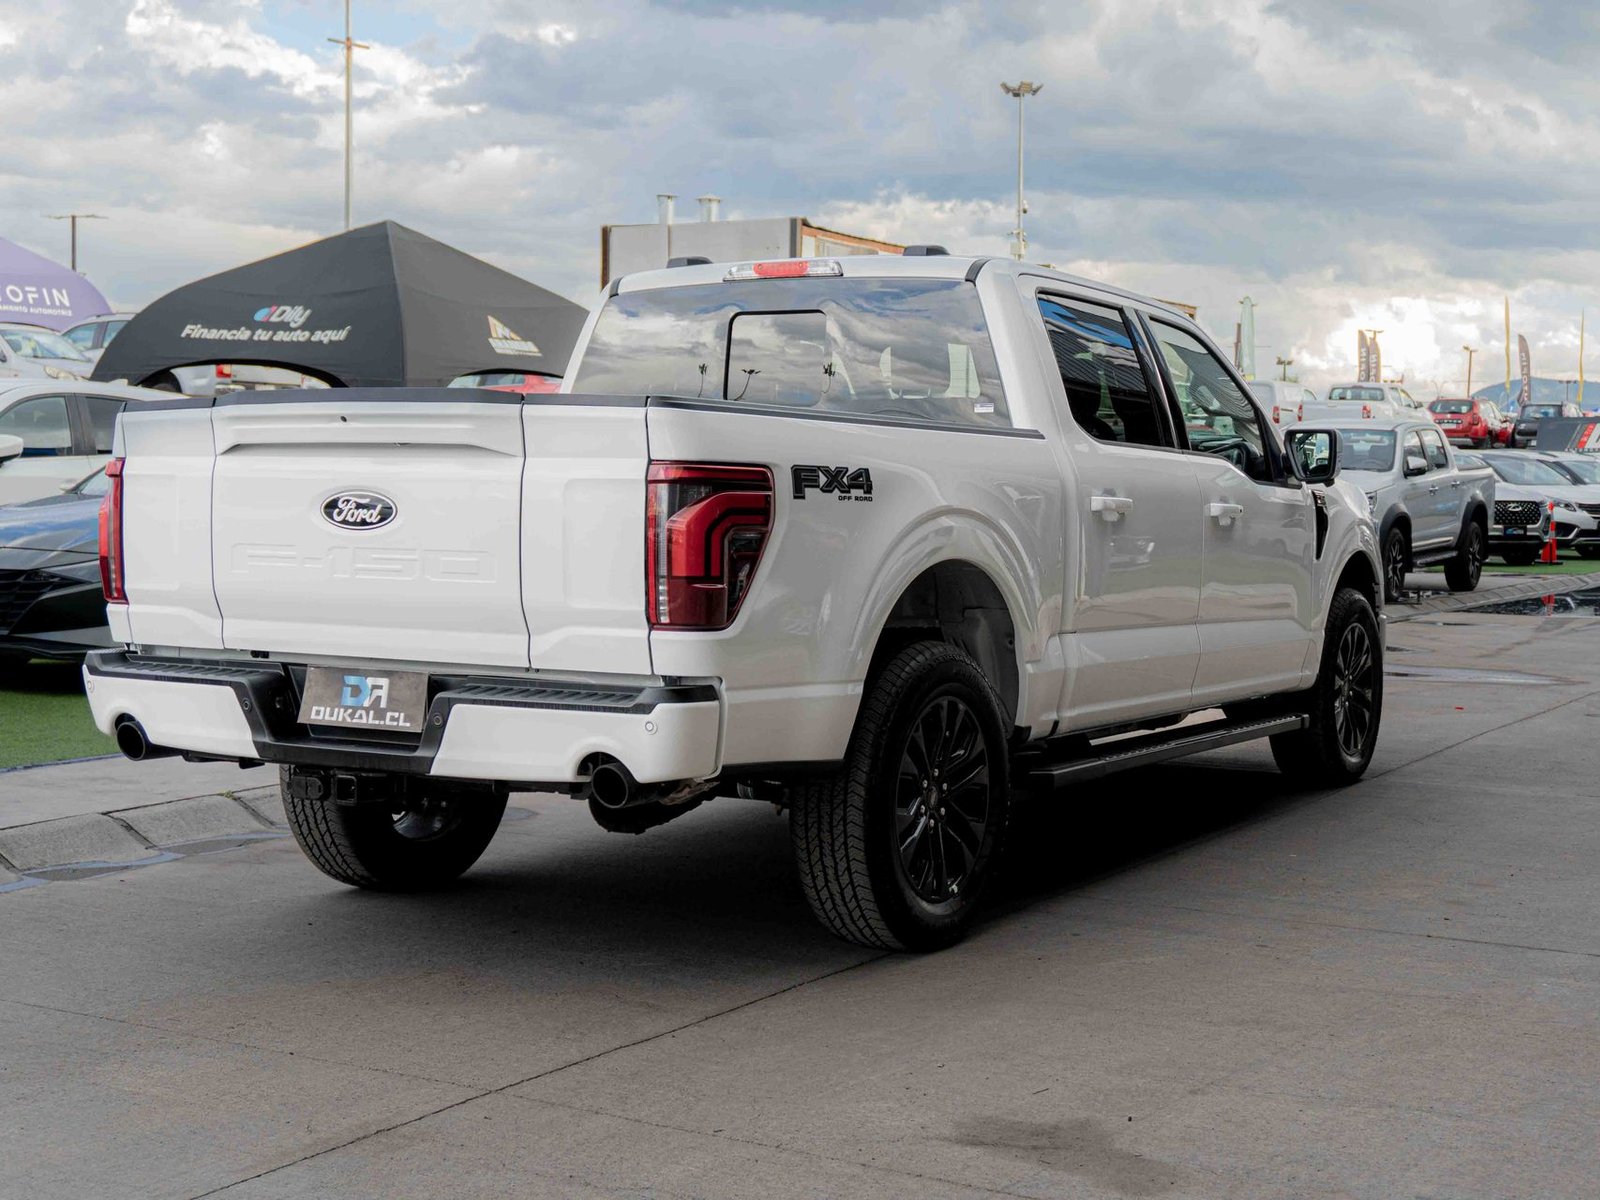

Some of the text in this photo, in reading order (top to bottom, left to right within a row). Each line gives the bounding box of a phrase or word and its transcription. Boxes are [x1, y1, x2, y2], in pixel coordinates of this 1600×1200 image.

[0, 285, 71, 307] OFIN
[180, 324, 352, 344] Financia tu auto aquí
[790, 464, 873, 500] FX4
[333, 496, 383, 524] Ford
[231, 542, 497, 584] F-150
[310, 705, 411, 727] DUKAL.CL
